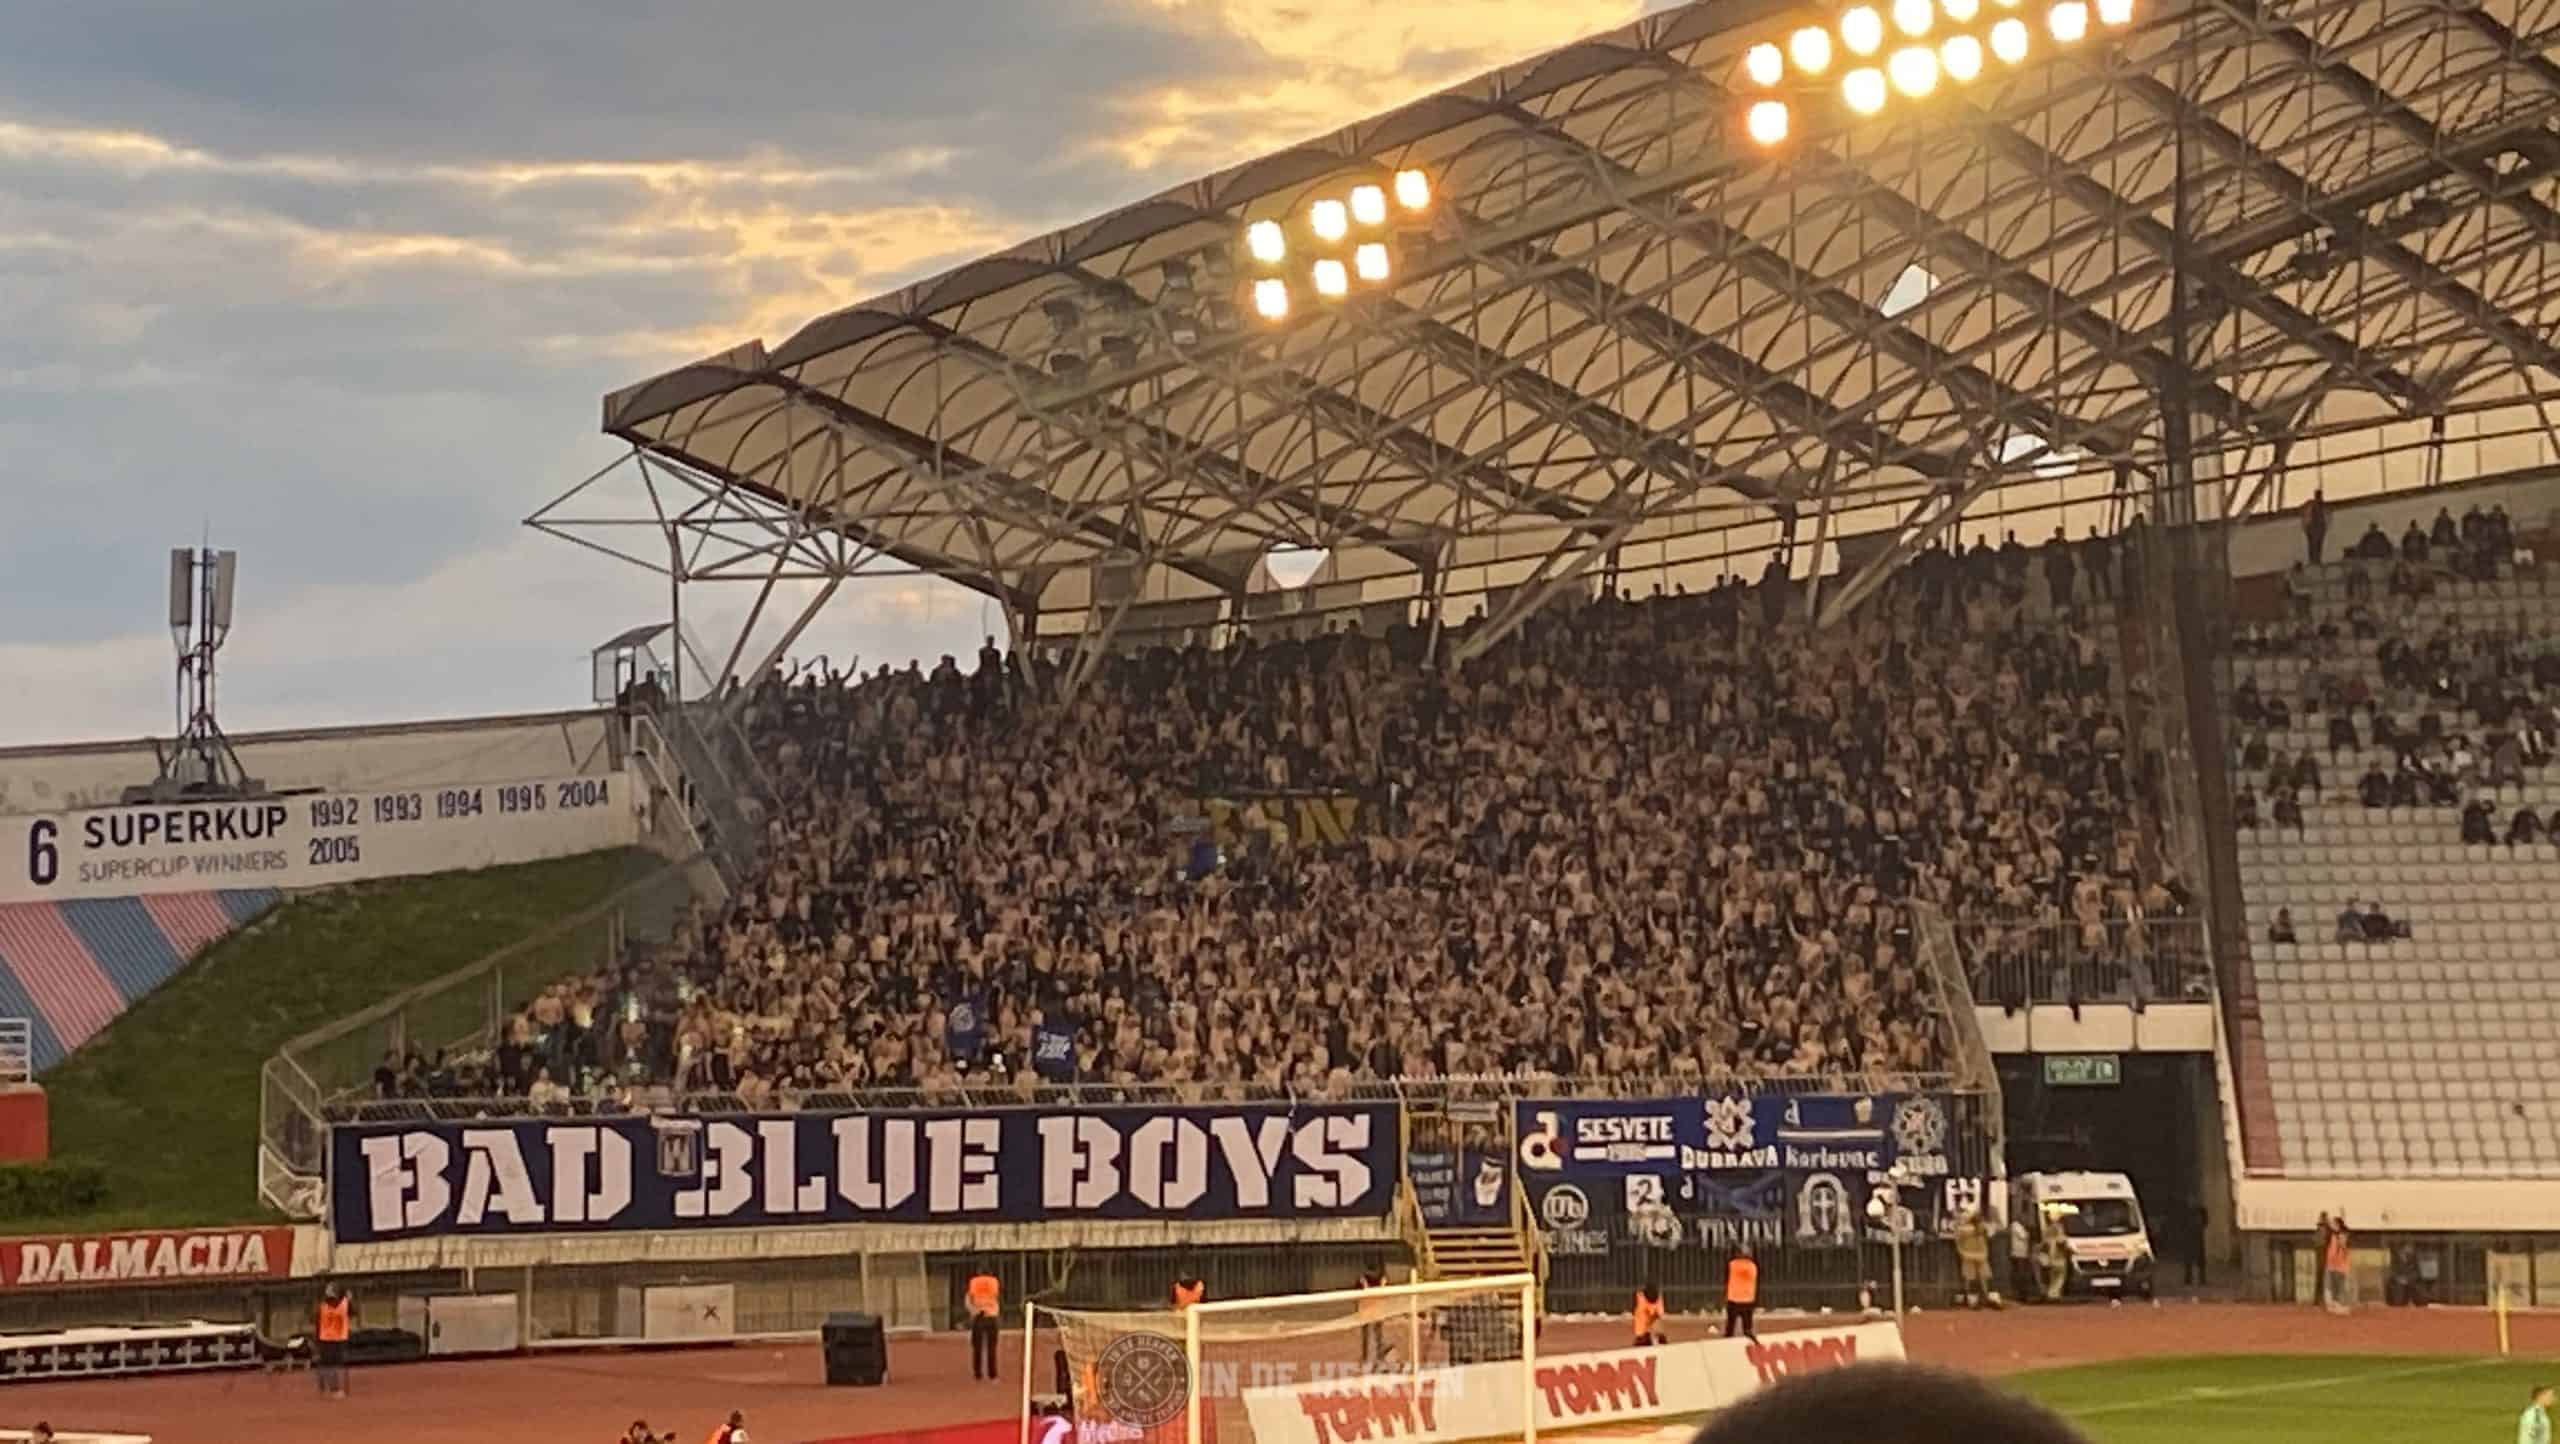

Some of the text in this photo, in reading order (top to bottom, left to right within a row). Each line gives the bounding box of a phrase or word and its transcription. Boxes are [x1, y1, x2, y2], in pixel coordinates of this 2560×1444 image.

[83, 805, 288, 849] SUPERKUP
[310, 779, 610, 828] 1992 1993 1994 1995 2004
[28, 818, 59, 886] 6
[78, 850, 289, 883] SUPERCUP WINNERS
[308, 835, 361, 865] 2005
[1576, 1116, 1674, 1142] SESVETE
[360, 1126, 633, 1232] BAD
[674, 1115, 1001, 1217] BLUE
[1037, 1113, 1372, 1209] BOYS
[16, 1233, 270, 1285] DALMACIJA
[1297, 1379, 1438, 1444] TOMMY
[1534, 1355, 1661, 1418] TOMMY
